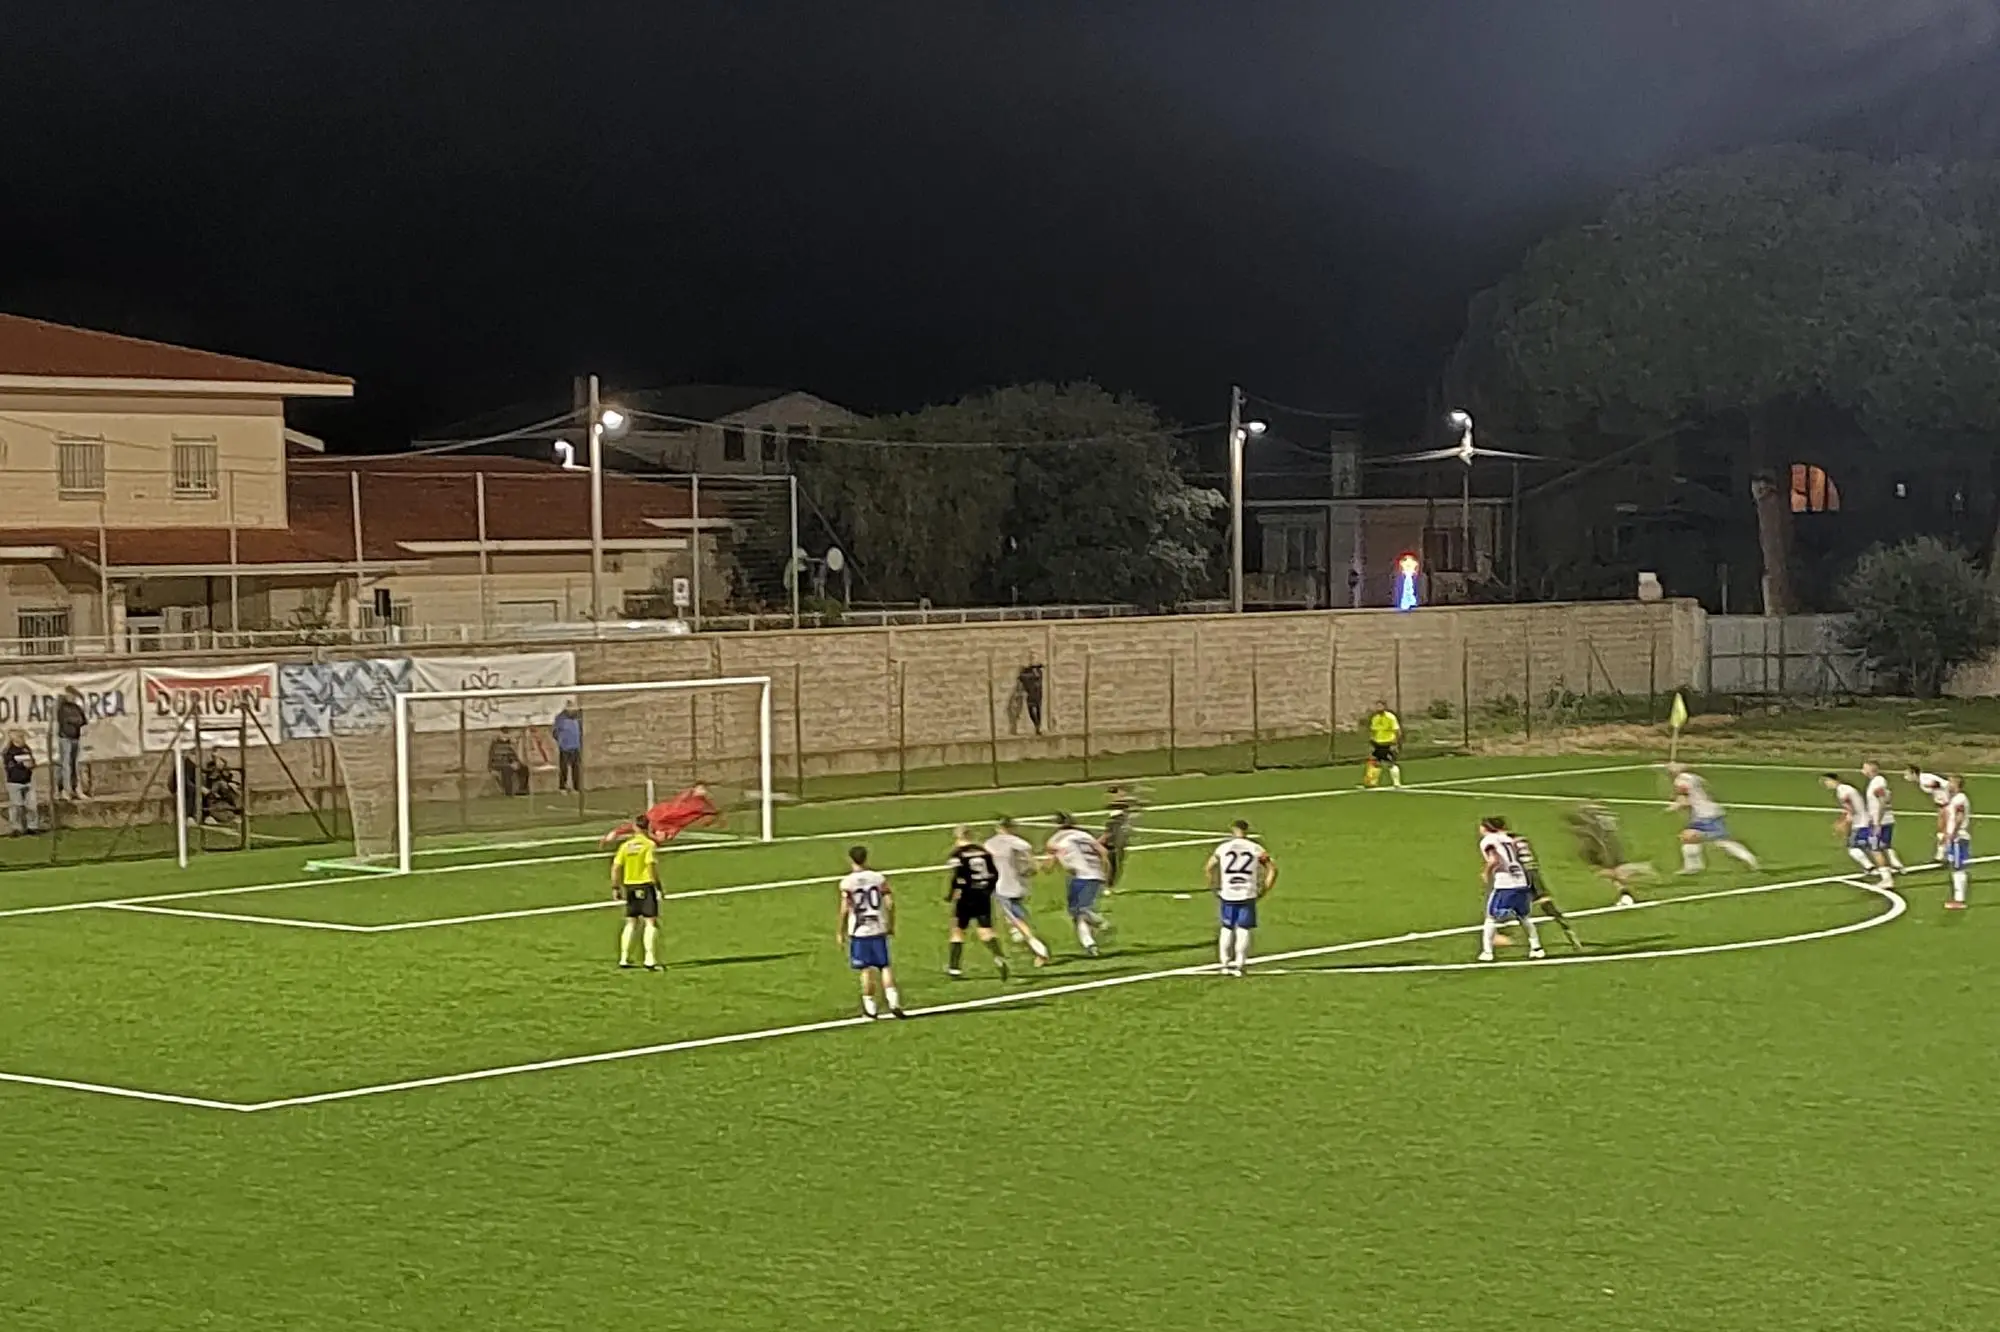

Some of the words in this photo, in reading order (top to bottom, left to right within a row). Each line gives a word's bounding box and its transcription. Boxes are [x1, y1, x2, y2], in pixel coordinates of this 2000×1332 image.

[28, 690, 126, 722] ARREA
[1224, 850, 1253, 875] 22
[853, 886, 880, 912] 20
